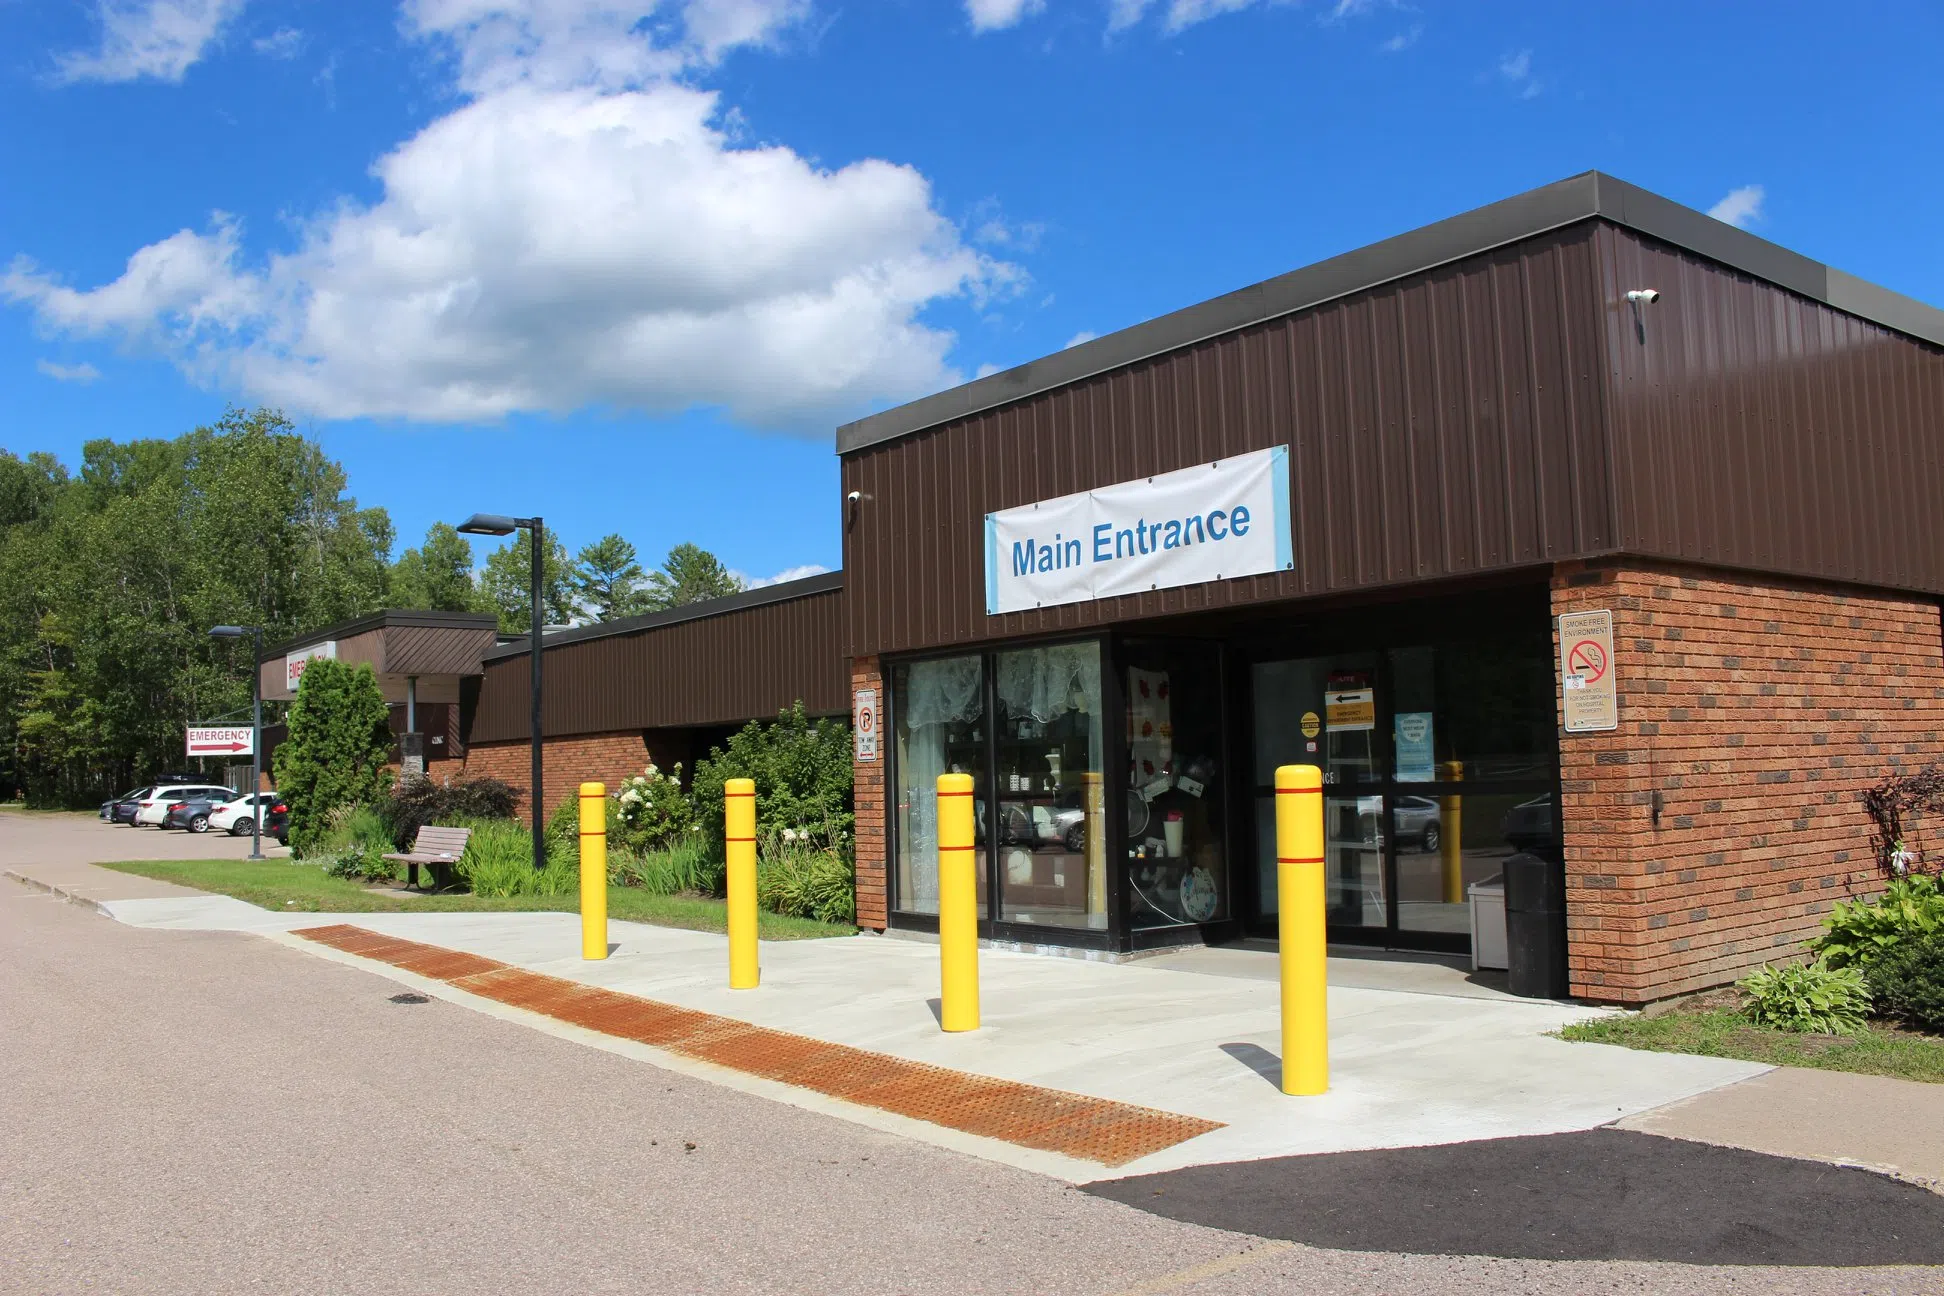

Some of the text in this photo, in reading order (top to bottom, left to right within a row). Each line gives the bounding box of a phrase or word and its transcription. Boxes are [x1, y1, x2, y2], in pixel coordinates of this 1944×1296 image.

[1012, 505, 1250, 577] Main Entrance
[1566, 617, 1605, 628] SMOKE FREE
[1565, 627, 1608, 637] ENVIRONMENT
[190, 730, 251, 741] EMERGENCY
